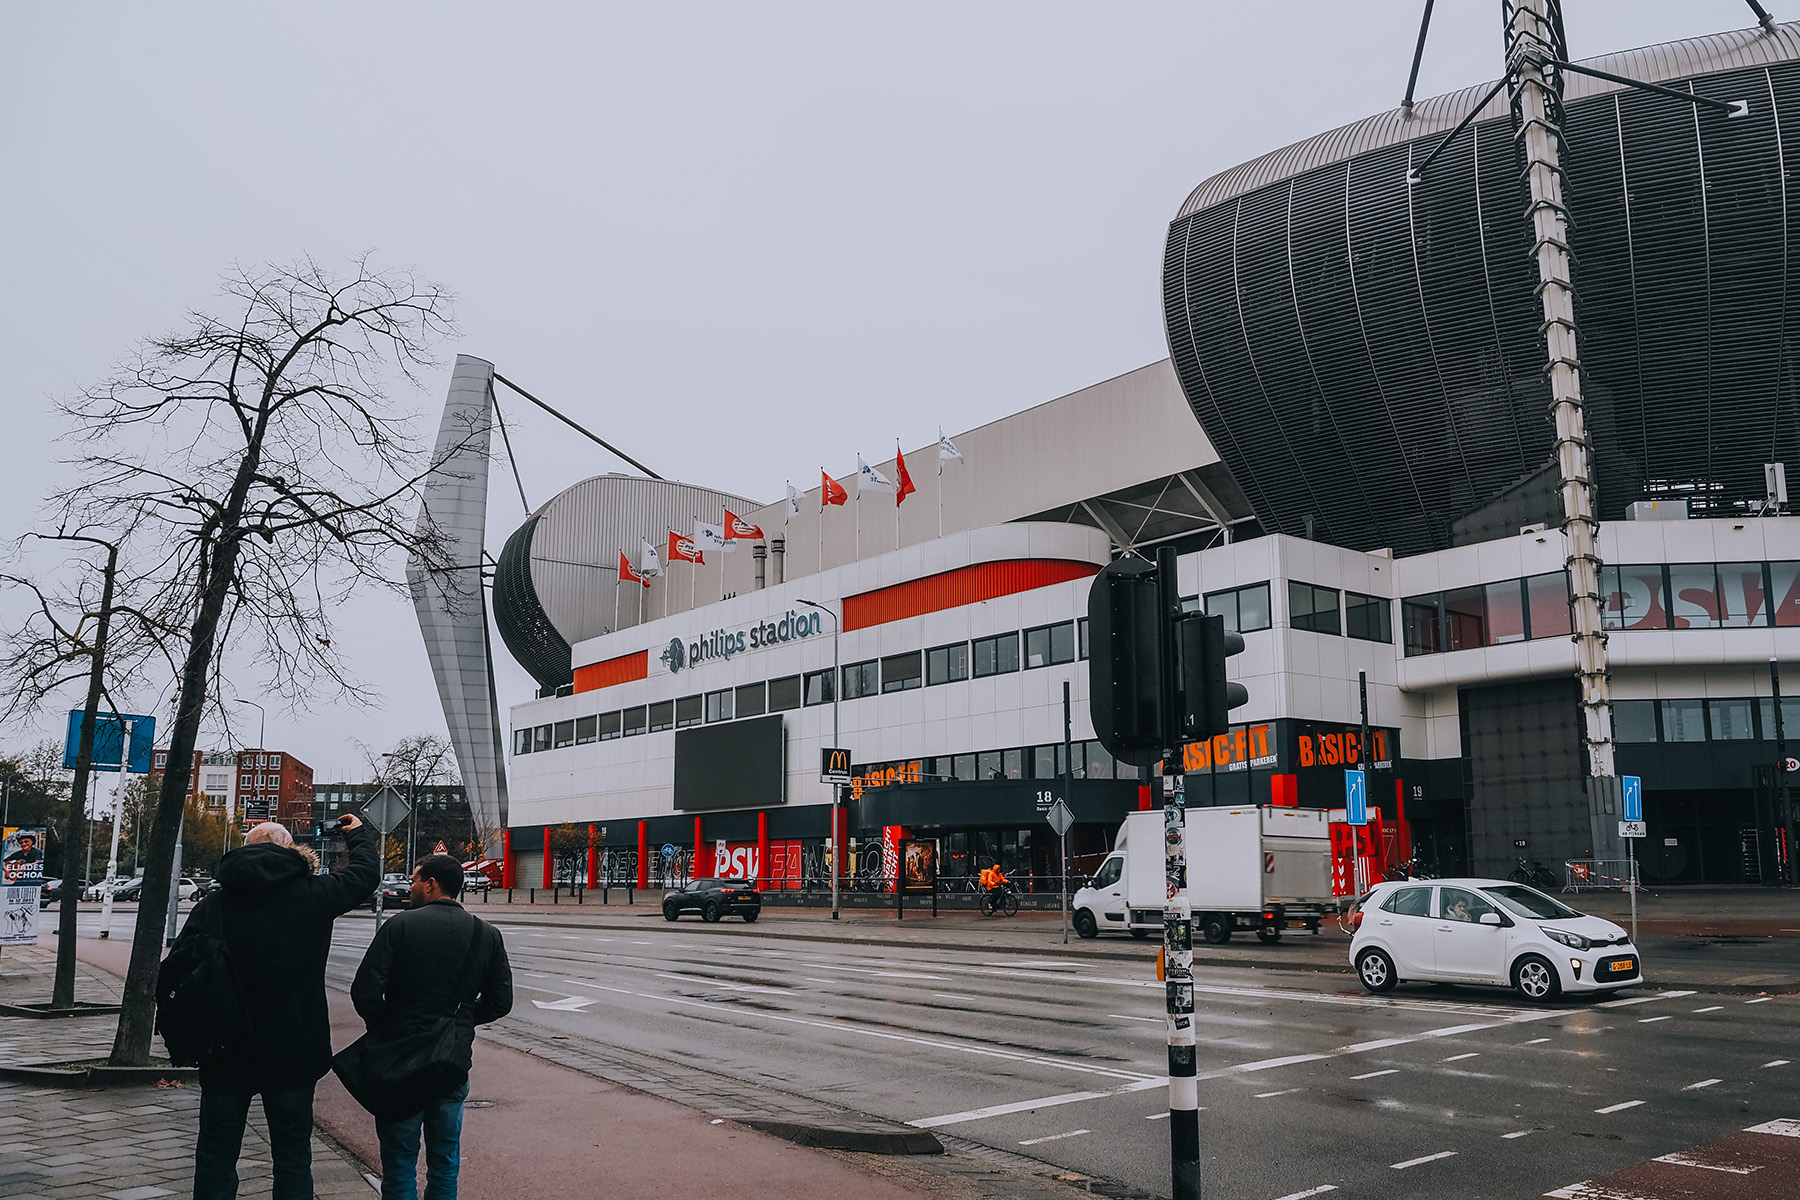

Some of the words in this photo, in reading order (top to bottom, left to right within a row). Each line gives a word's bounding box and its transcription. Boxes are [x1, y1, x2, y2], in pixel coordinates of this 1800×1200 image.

[689, 628, 746, 668] philips
[749, 609, 822, 648] stadion
[1036, 790, 1052, 803] 18
[1412, 785, 1423, 798] 19
[6, 863, 44, 871] ELIADES
[714, 847, 759, 882] PSV
[9, 871, 43, 879] OCHOA
